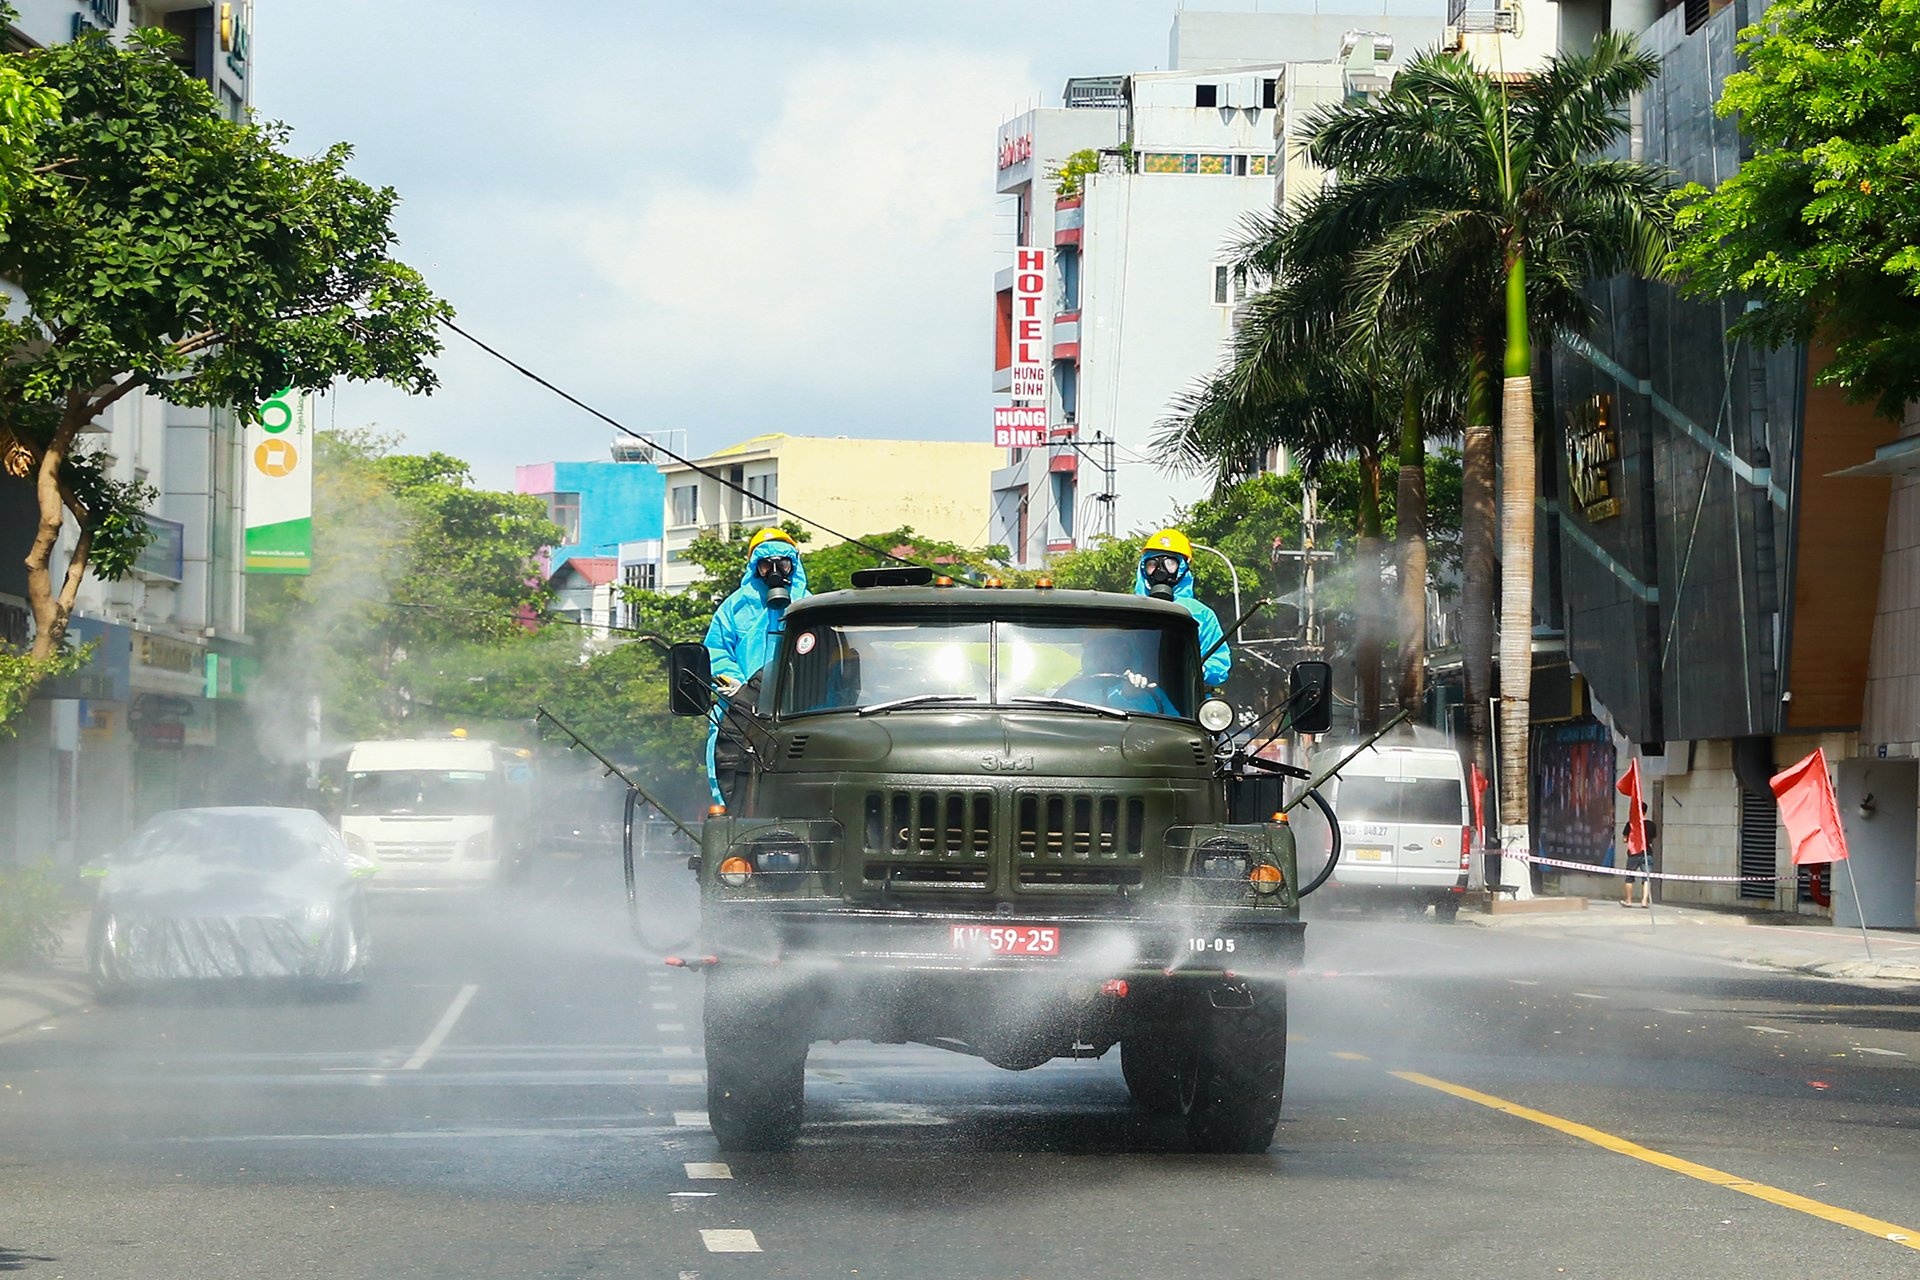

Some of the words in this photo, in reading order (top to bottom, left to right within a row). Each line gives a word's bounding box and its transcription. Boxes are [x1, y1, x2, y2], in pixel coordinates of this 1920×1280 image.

[1018, 250, 1044, 363] HOTEL
[1014, 366, 1044, 380] HƯNG
[995, 409, 1046, 427] HƯNG
[1188, 937, 1236, 953] 10-05
